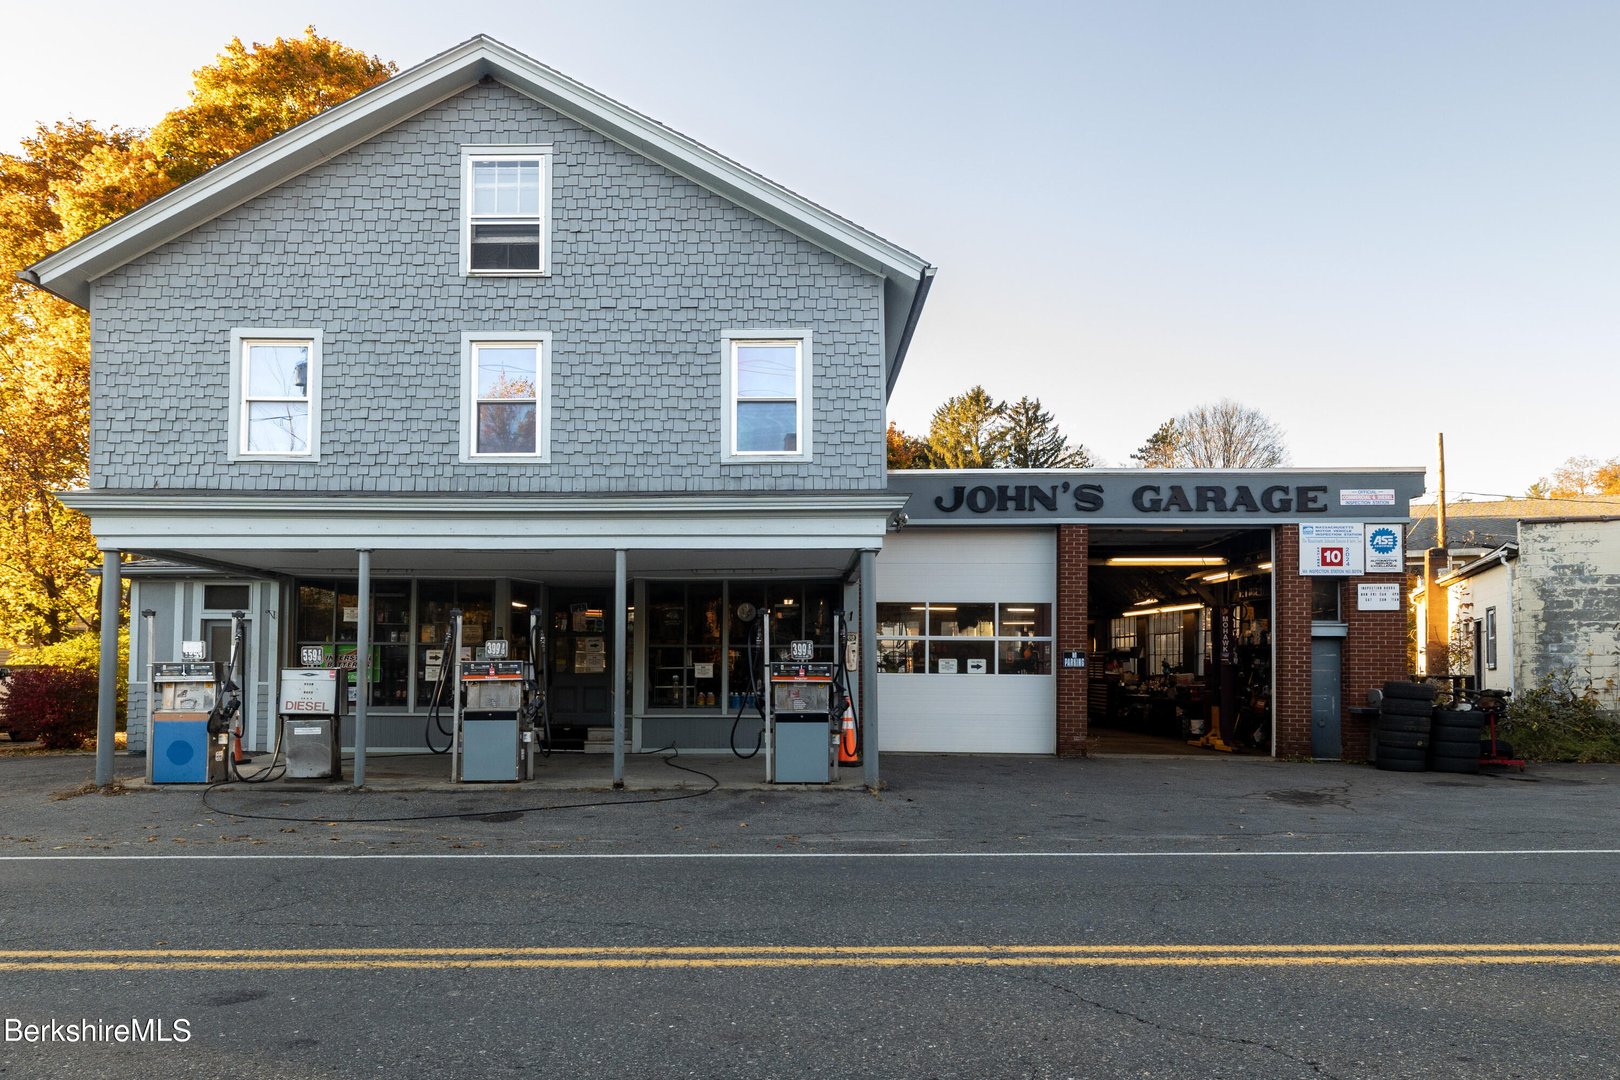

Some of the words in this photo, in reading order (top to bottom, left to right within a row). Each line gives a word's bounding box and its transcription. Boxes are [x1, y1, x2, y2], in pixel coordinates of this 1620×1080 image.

[935, 481, 1105, 513] JOHN'S
[1133, 485, 1328, 513] GARAGE
[1373, 535, 1393, 545] ASE
[1324, 550, 1341, 563] 10
[1222, 616, 1230, 652] MOHAWK
[1064, 658, 1084, 667] PARKING
[285, 701, 329, 712] DIESEL
